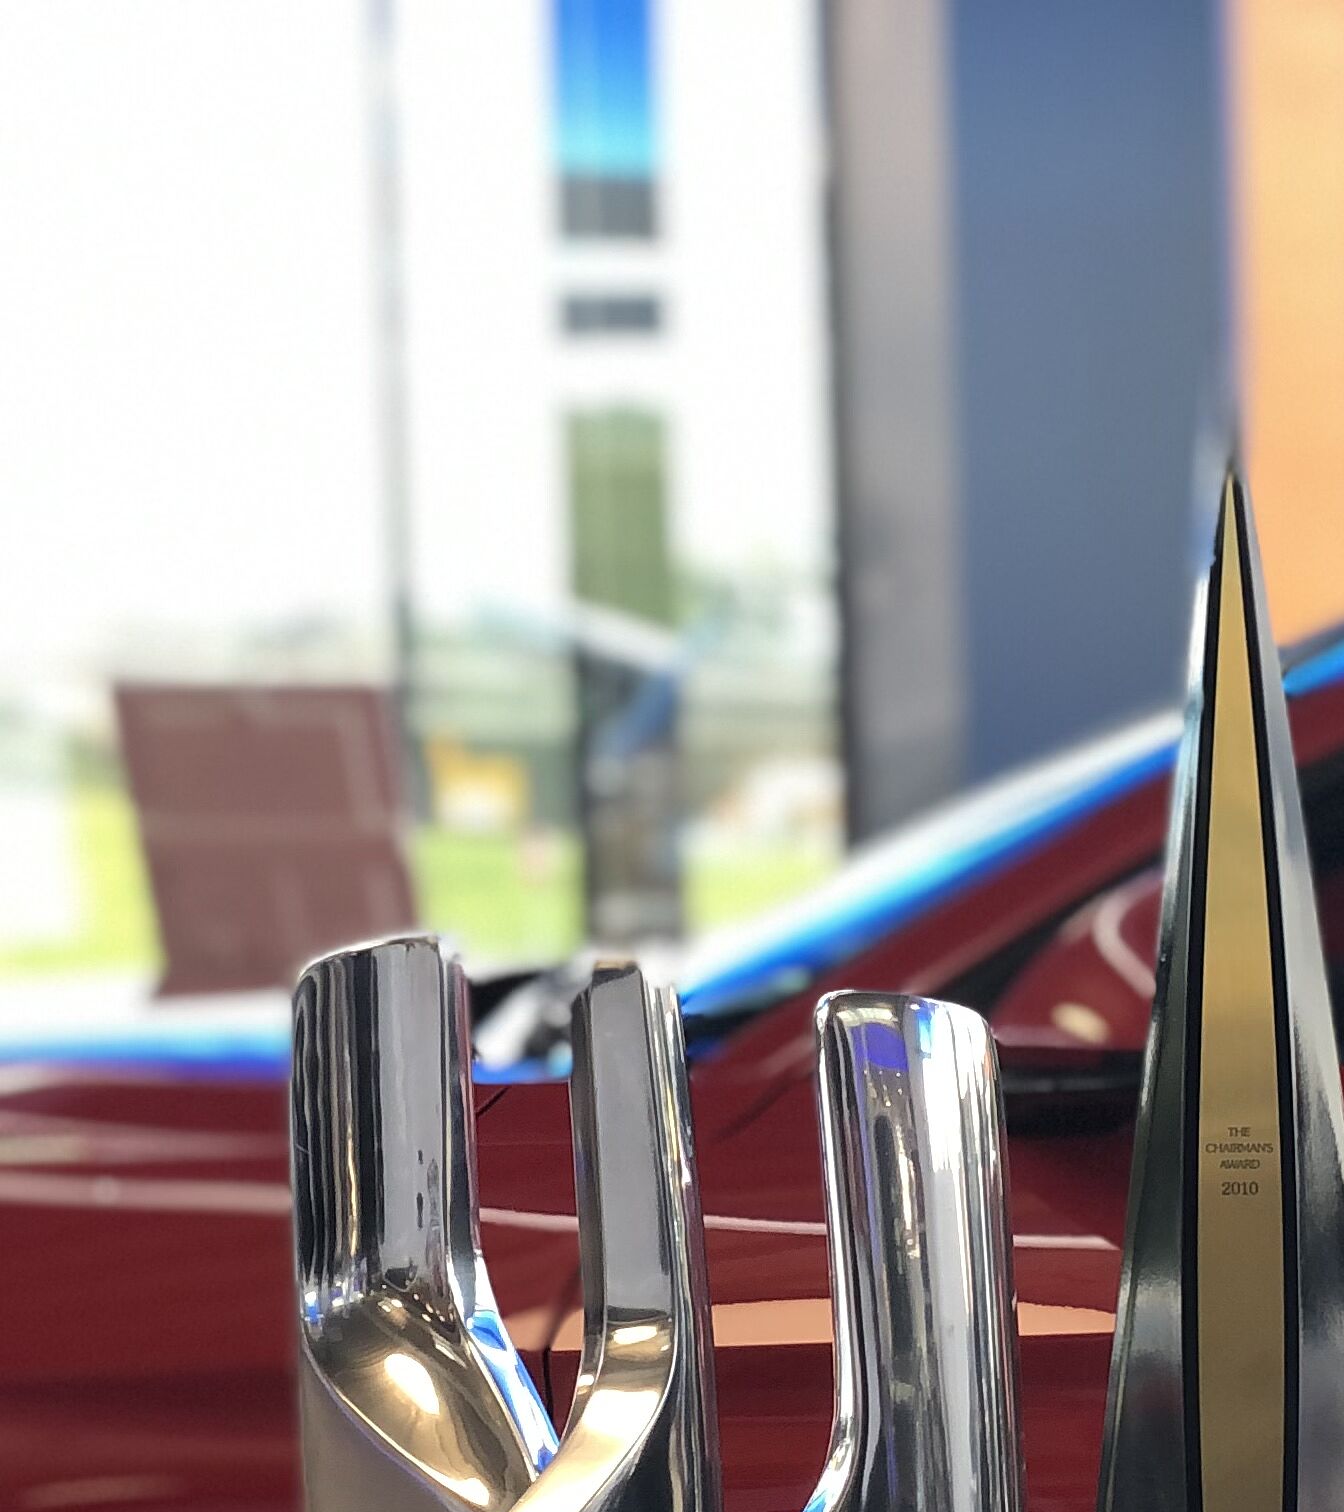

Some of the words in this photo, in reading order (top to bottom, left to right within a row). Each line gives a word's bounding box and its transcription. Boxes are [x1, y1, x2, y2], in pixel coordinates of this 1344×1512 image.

[1227, 1126, 1251, 1137] THE
[1219, 1159, 1261, 1169] AWARD
[1221, 1181, 1259, 1196] 2010
